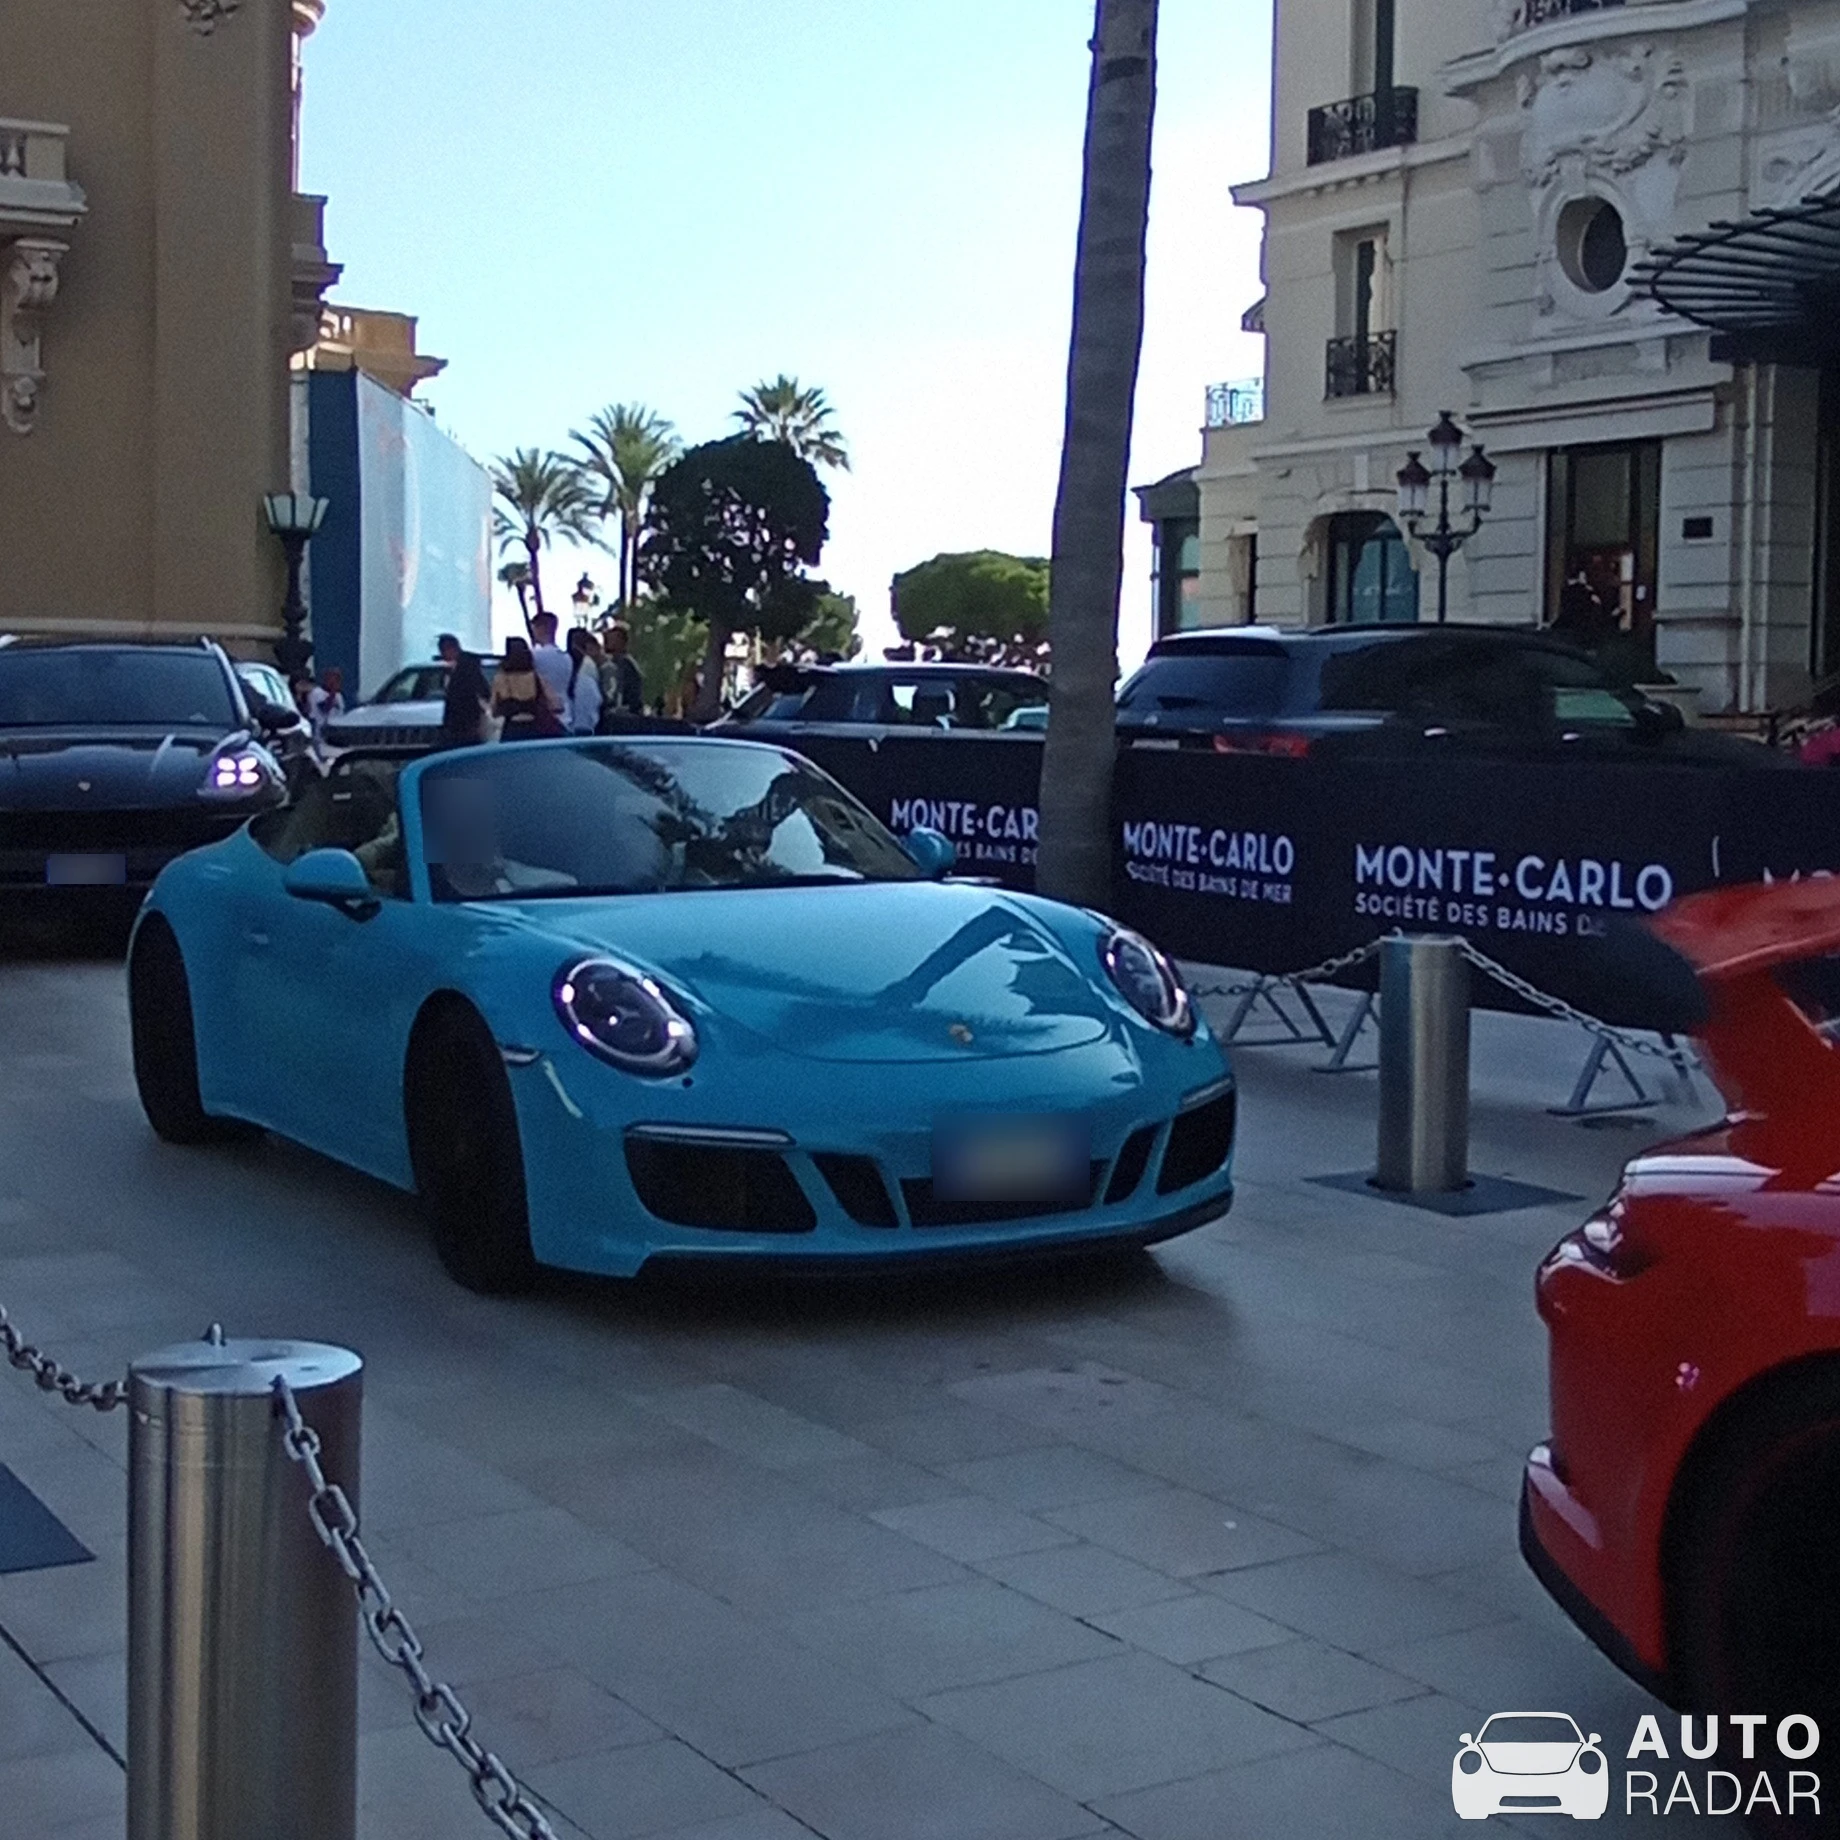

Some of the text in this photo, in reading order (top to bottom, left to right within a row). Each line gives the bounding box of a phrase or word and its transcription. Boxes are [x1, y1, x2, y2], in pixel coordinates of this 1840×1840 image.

[890, 798, 1040, 841] MONTE·CAR
[1123, 821, 1294, 875] MONTE·CARLO
[1355, 843, 1674, 911] MONTE·CARLO
[1355, 892, 1439, 922] SOCIÉTÉ
[1447, 902, 1488, 927] DES
[1497, 906, 1567, 935] BAINS
